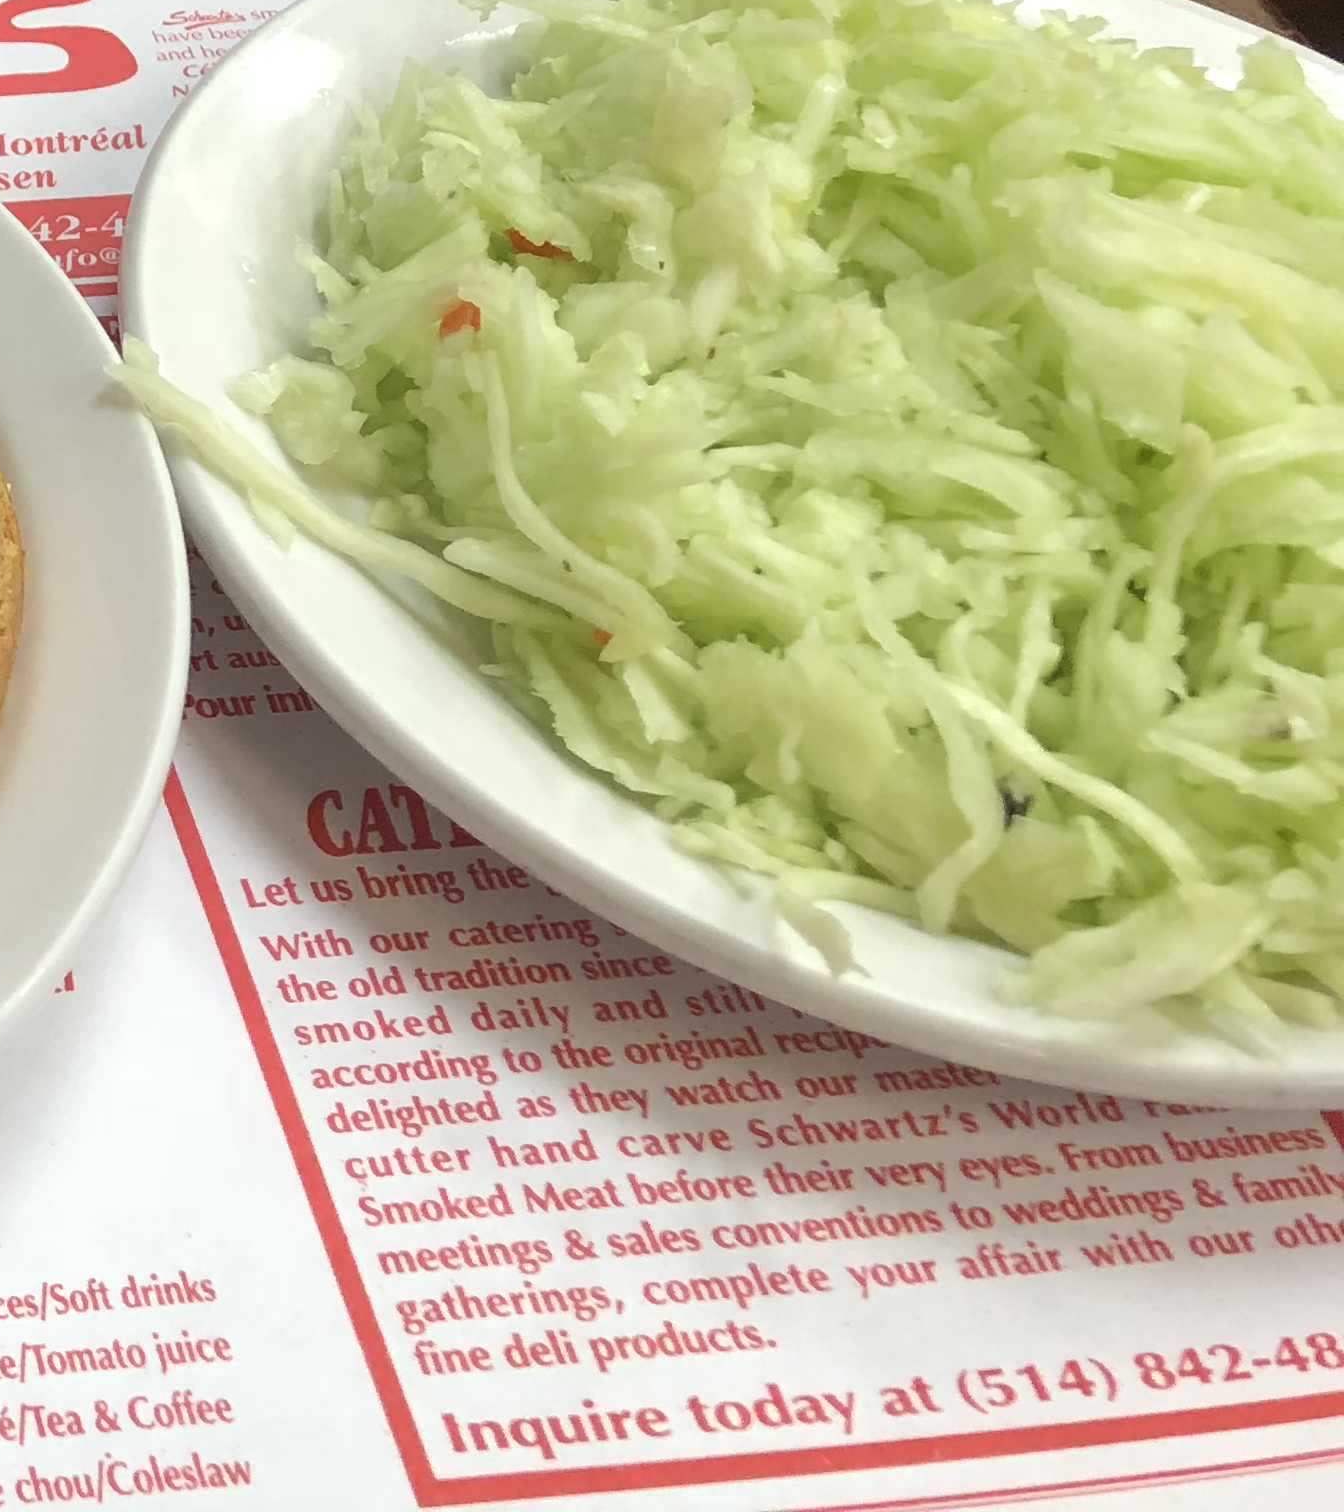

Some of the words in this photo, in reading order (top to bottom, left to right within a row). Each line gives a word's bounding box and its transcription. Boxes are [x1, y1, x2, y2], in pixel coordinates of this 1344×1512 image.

[241, 877, 304, 910] Let
[311, 880, 355, 904] us
[356, 865, 463, 904] bring
[465, 856, 528, 892] the
[260, 930, 352, 962] With
[369, 929, 430, 954] our
[448, 914, 601, 948] catering
[277, 973, 336, 1003] the
[348, 967, 407, 997] old
[416, 956, 573, 992] tradition
[580, 950, 675, 981] since
[295, 1005, 454, 1046] smoked
[471, 999, 570, 1034] daily
[593, 992, 671, 1025] and
[313, 1050, 500, 1091] according
[502, 1049, 544, 1074] to
[553, 1037, 614, 1070] the
[624, 1026, 768, 1073] original
[326, 1088, 501, 1139] delighted
[519, 1096, 556, 1119] as
[570, 1083, 651, 1118] they
[666, 1071, 784, 1108] watch
[794, 1073, 857, 1102] our
[872, 1062, 1002, 1092] master
[345, 1148, 470, 1183] cutter
[487, 1130, 599, 1169] hand
[617, 1128, 735, 1157] carve
[748, 1105, 982, 1150] Schwartz's
[992, 1095, 1126, 1129] World
[358, 1185, 515, 1227] Smoked
[523, 1180, 623, 1213] Meat
[628, 1170, 755, 1205] before
[764, 1160, 854, 1195] their
[866, 1161, 948, 1193] very
[960, 1154, 1056, 1188] eyes.
[1058, 1143, 1166, 1172] From
[1162, 1128, 1330, 1165] business
[378, 1235, 555, 1275] meetings
[565, 1230, 597, 1261] &
[608, 1220, 703, 1257] sales
[712, 1206, 945, 1250] conventions
[948, 1203, 996, 1231] to
[1004, 1186, 1185, 1224] weddings
[1192, 1179, 1225, 1208] &
[122, 1272, 216, 1308] drinks
[396, 1283, 624, 1337] gatherings,
[641, 1263, 831, 1310] complete
[848, 1260, 936, 1298] your
[960, 1241, 1062, 1280] affair
[1082, 1230, 1176, 1268] with
[1188, 1229, 1255, 1257] our
[154, 1331, 232, 1375] juice
[415, 1341, 491, 1375] fine
[504, 1330, 580, 1368] deli
[588, 1322, 777, 1373] products.
[96, 1401, 120, 1432] &
[128, 1392, 233, 1430] Coffee
[442, 1401, 671, 1462] Inquire
[688, 1384, 855, 1433] today
[881, 1378, 939, 1416] at
[957, 1360, 1120, 1415] (514)
[15, 1451, 252, 1505] chou/Coleslaw
